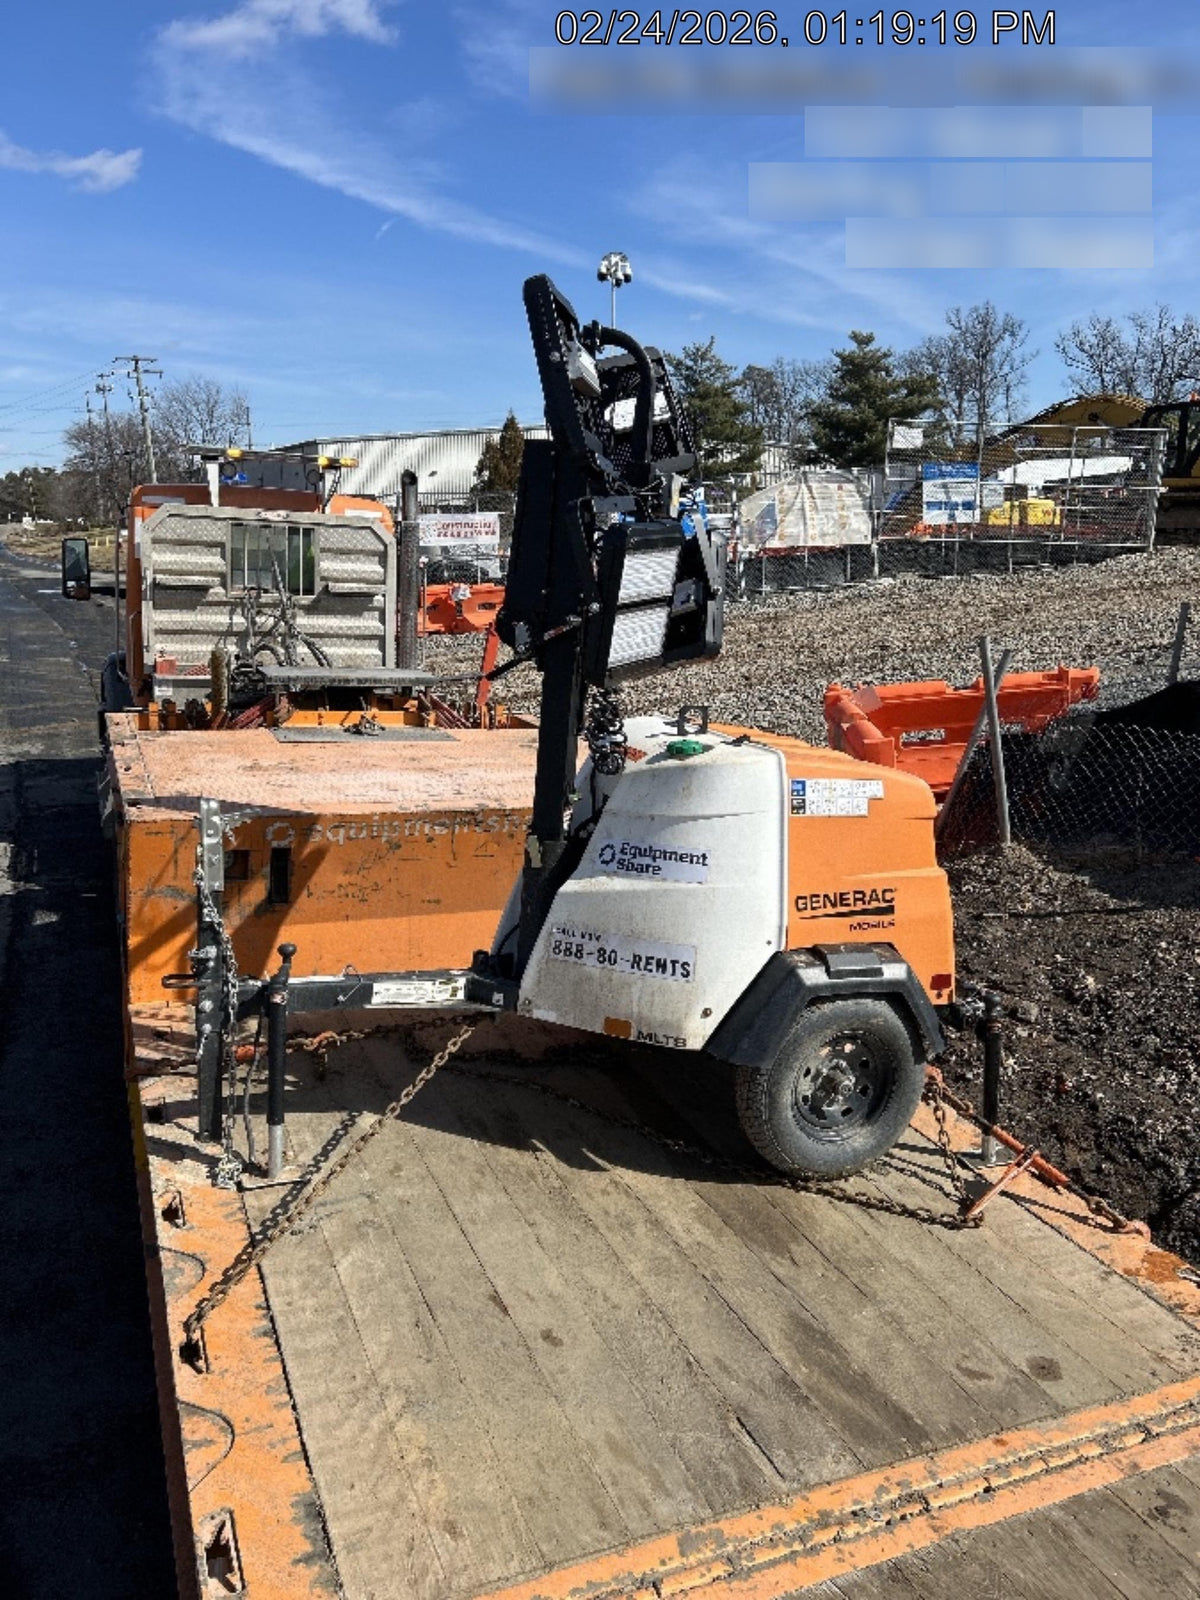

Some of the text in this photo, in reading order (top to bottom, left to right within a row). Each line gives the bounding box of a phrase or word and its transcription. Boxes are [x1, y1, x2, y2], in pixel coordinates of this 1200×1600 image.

[616, 857, 662, 875] Share
[619, 842, 709, 867] Equipment
[794, 888, 896, 912] GENERAC
[552, 940, 691, 979] 888-80-RENTS
